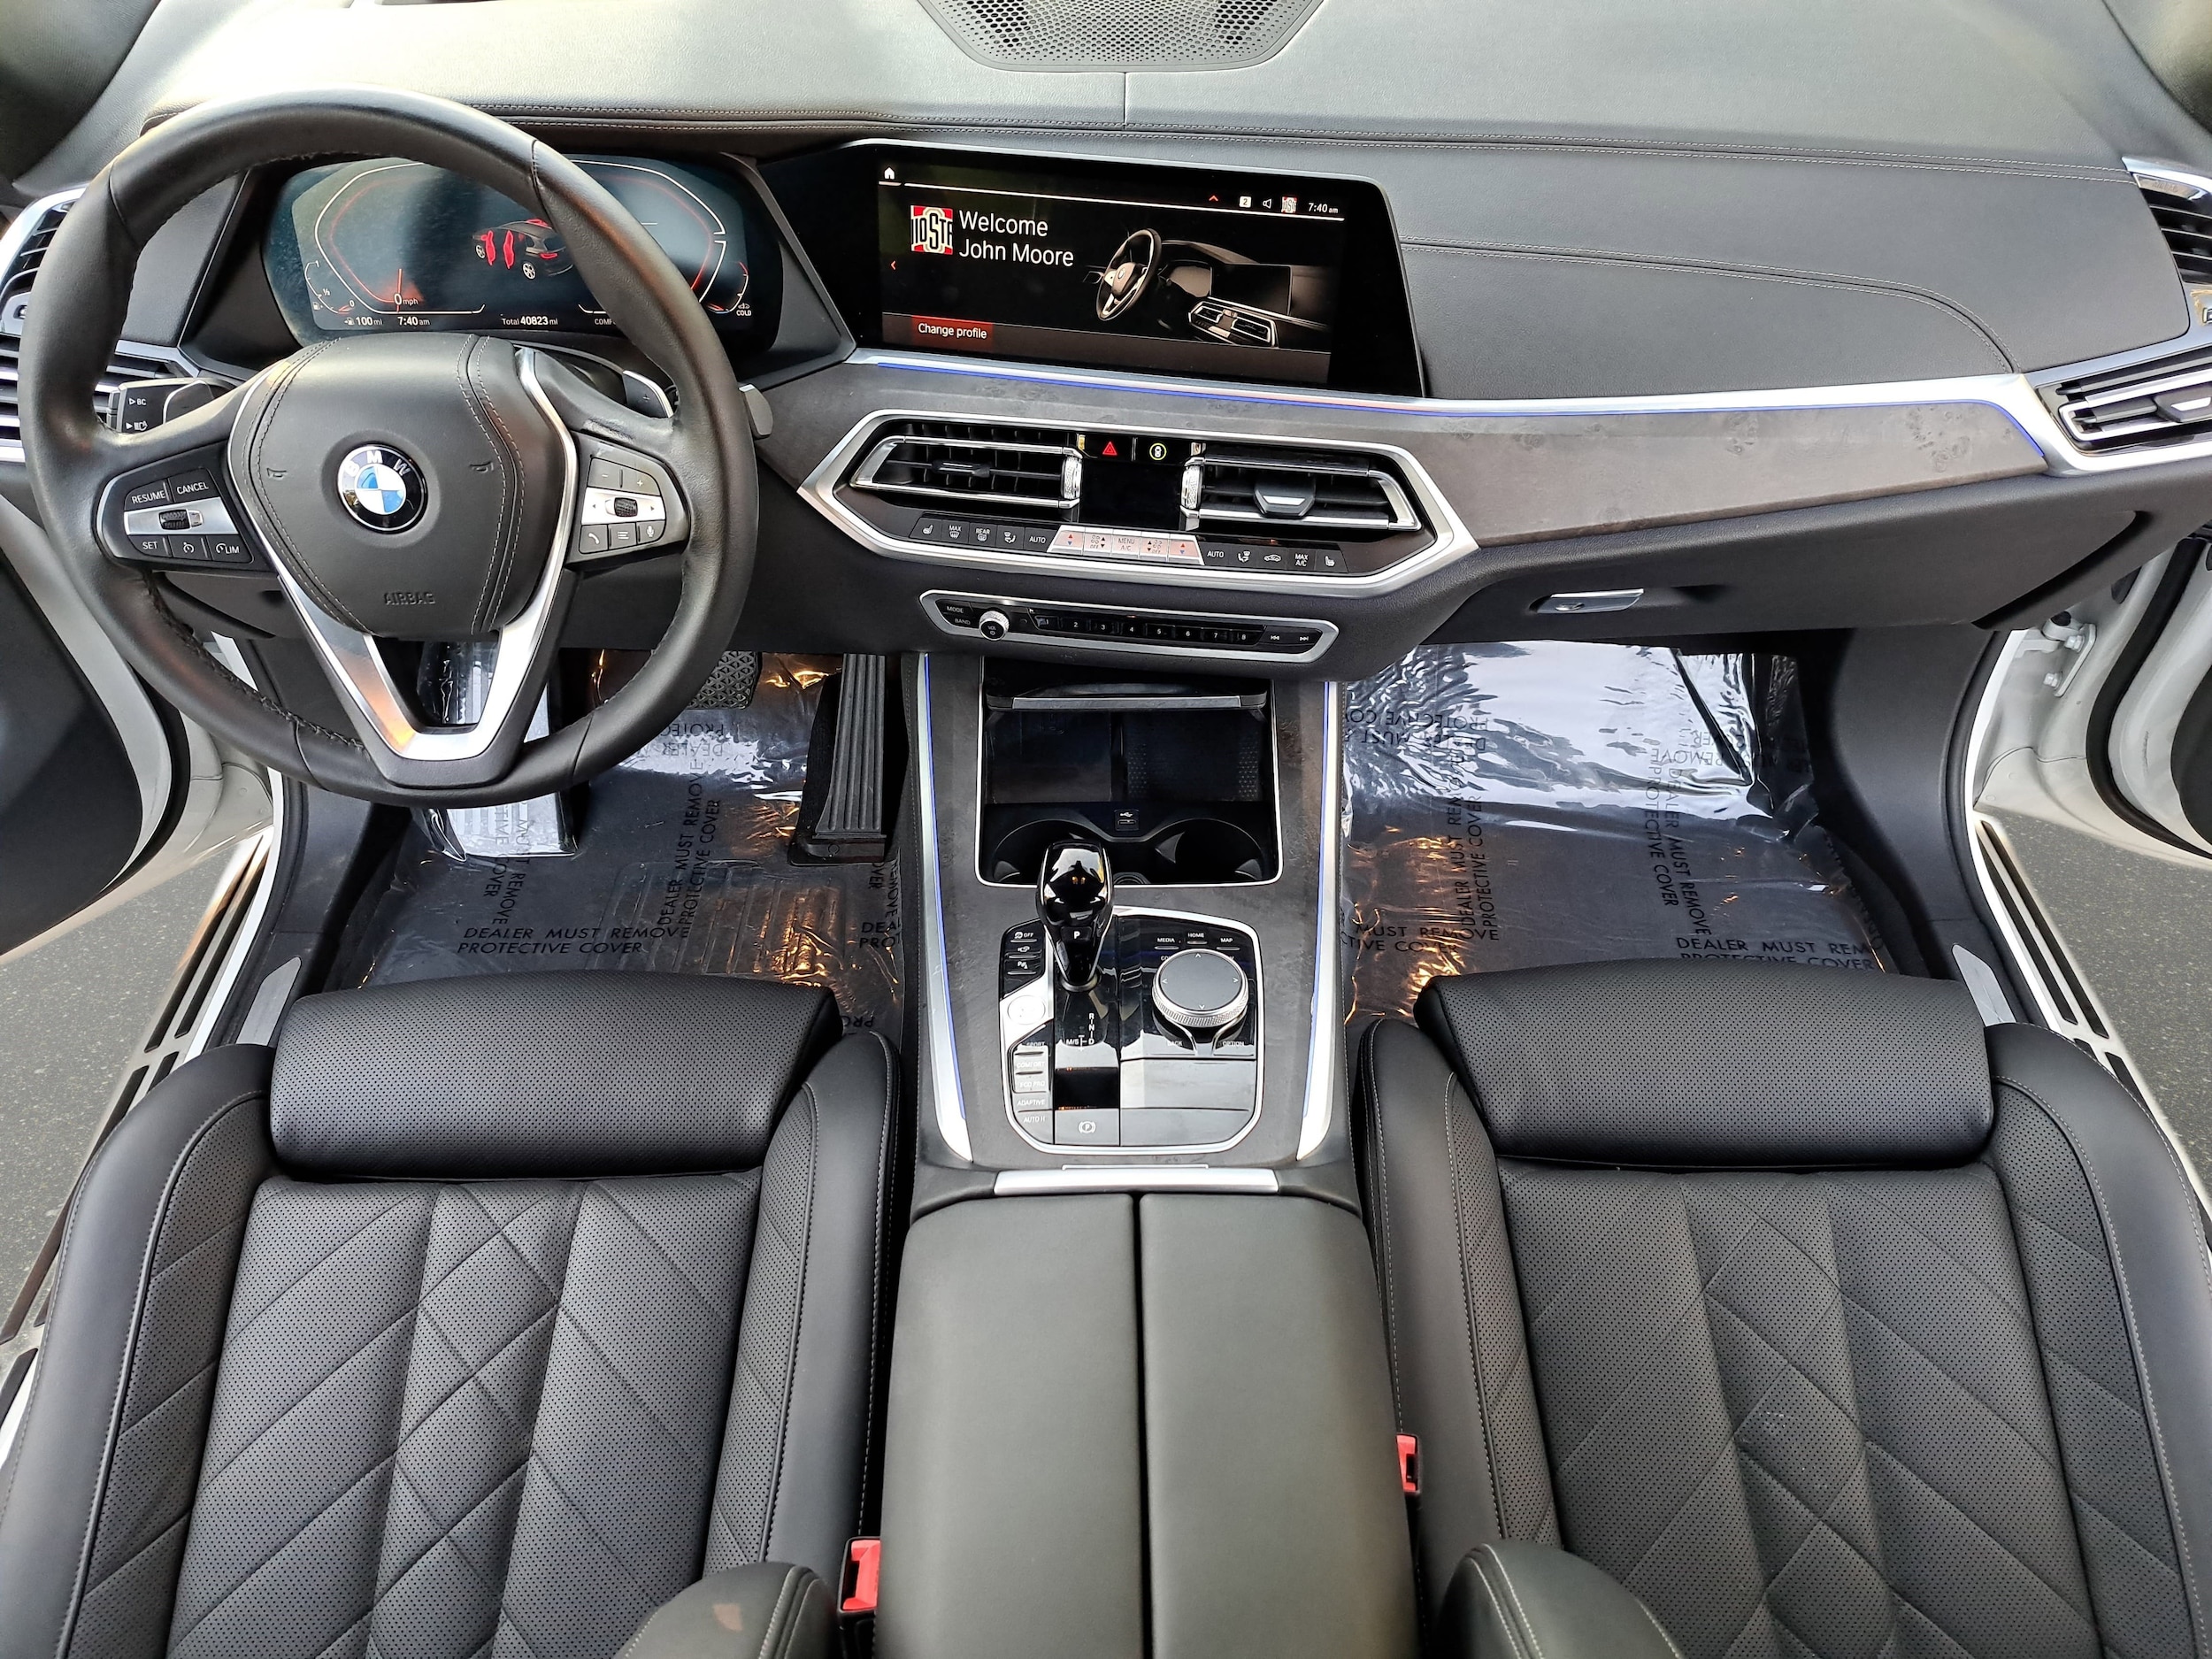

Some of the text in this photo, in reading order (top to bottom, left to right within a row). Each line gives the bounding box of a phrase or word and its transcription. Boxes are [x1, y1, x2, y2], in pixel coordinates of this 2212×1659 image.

[1308, 203, 1328, 212] 7:40
[958, 210, 1048, 237] Welcome
[958, 239, 1074, 267] John Moore
[394, 293, 403, 305] 0
[356, 316, 373, 326] 100
[398, 316, 419, 326] 7:40
[520, 316, 549, 326] 40823
[918, 323, 987, 340] Change profile
[344, 449, 411, 477] BMW
[176, 482, 209, 495] CANCEL
[131, 490, 166, 504] RESUME
[142, 541, 158, 549] SET
[225, 545, 240, 554] LIM
[383, 591, 435, 606] AIRBAG
[657, 758, 703, 928] DEALER MUST REMOVE
[1644, 765, 1679, 907] PROTECTIVE COVER
[1663, 767, 1712, 935] DEALER MUST REMOVE
[678, 799, 721, 925] PROTECTIVE COVER
[1468, 795, 1498, 927] PROTECTIVE COVER
[492, 872, 526, 925] REMOVE
[1454, 879, 1476, 926] DEALER
[463, 927, 690, 939] DEALER MUST REMOVE
[1419, 927, 1500, 941] REMOVE
[457, 942, 643, 954] PROTECTIVE COVER
[1676, 937, 1748, 951] DEALER
[1762, 941, 1816, 954] MUST
